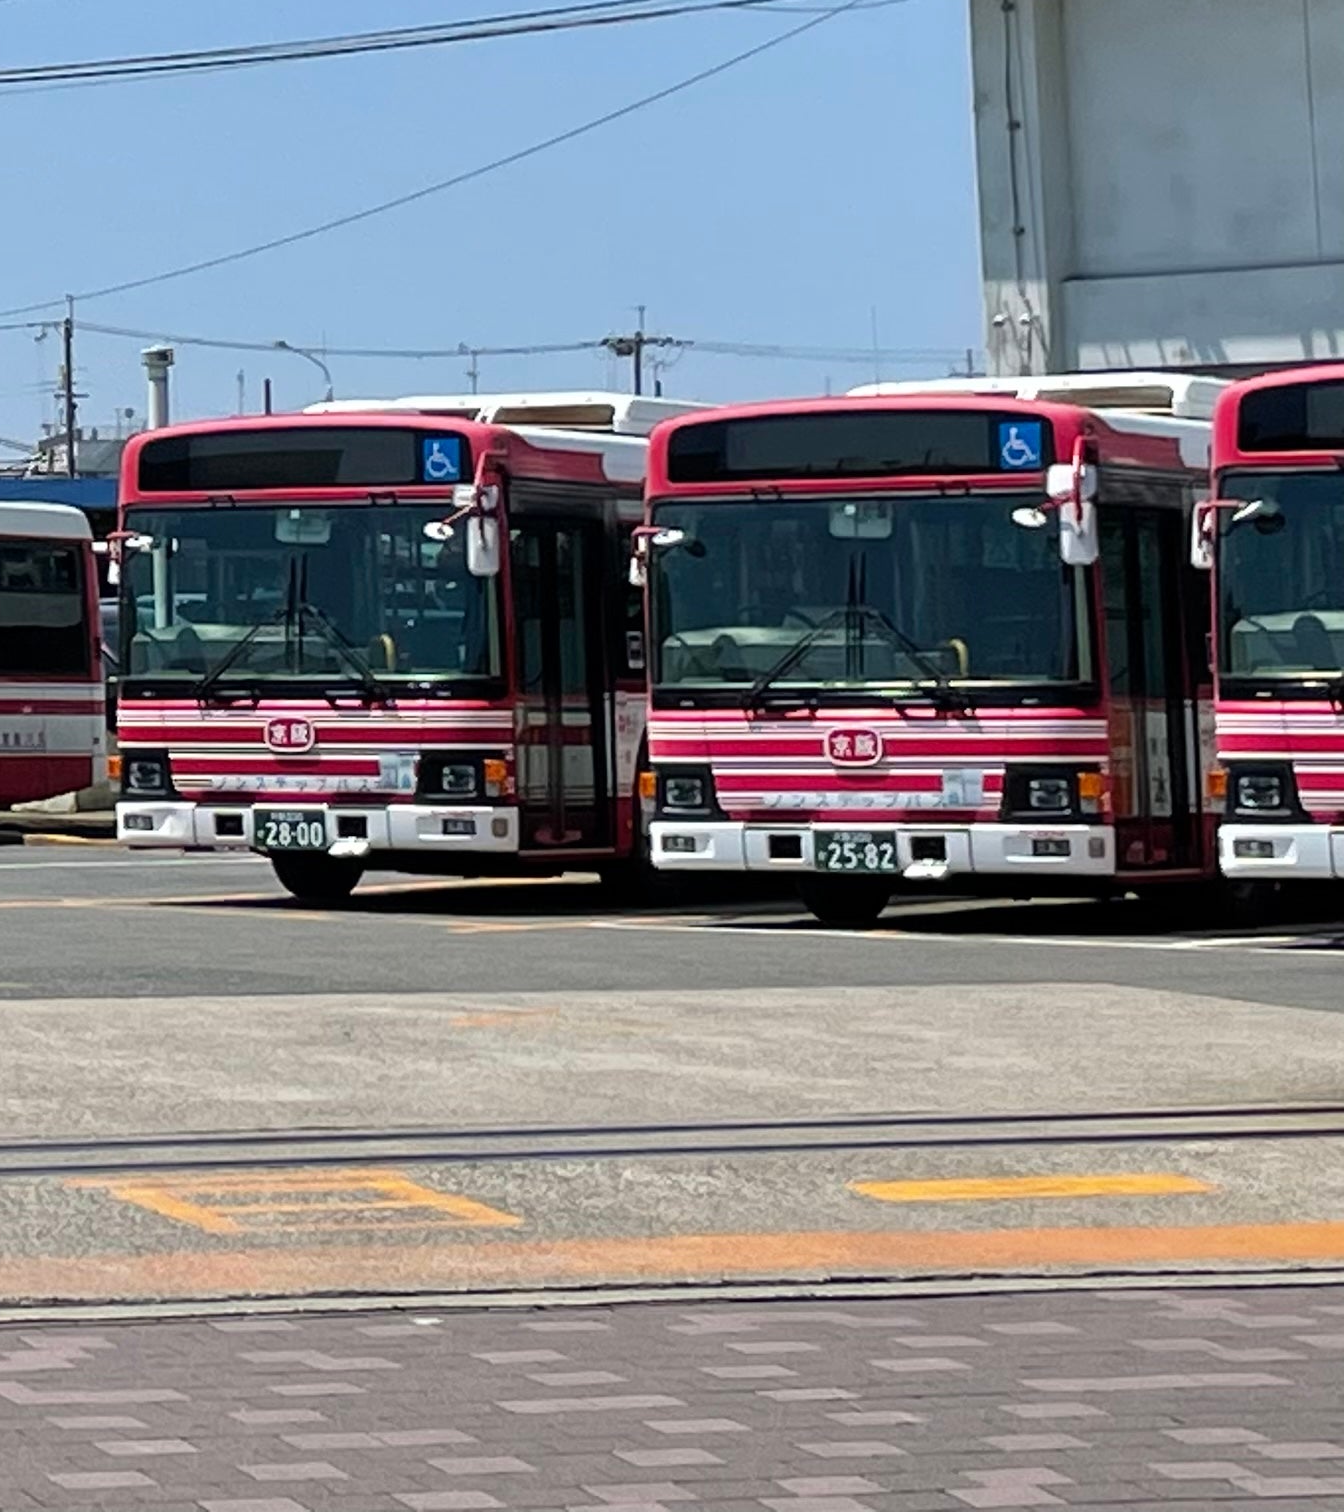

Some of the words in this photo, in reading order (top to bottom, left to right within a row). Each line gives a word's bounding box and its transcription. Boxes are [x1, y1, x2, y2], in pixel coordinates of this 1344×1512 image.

[269, 723, 309, 745] 京阪
[830, 734, 877, 757] 京阪
[264, 821, 324, 847] 28-00
[827, 841, 895, 870] 25-82
